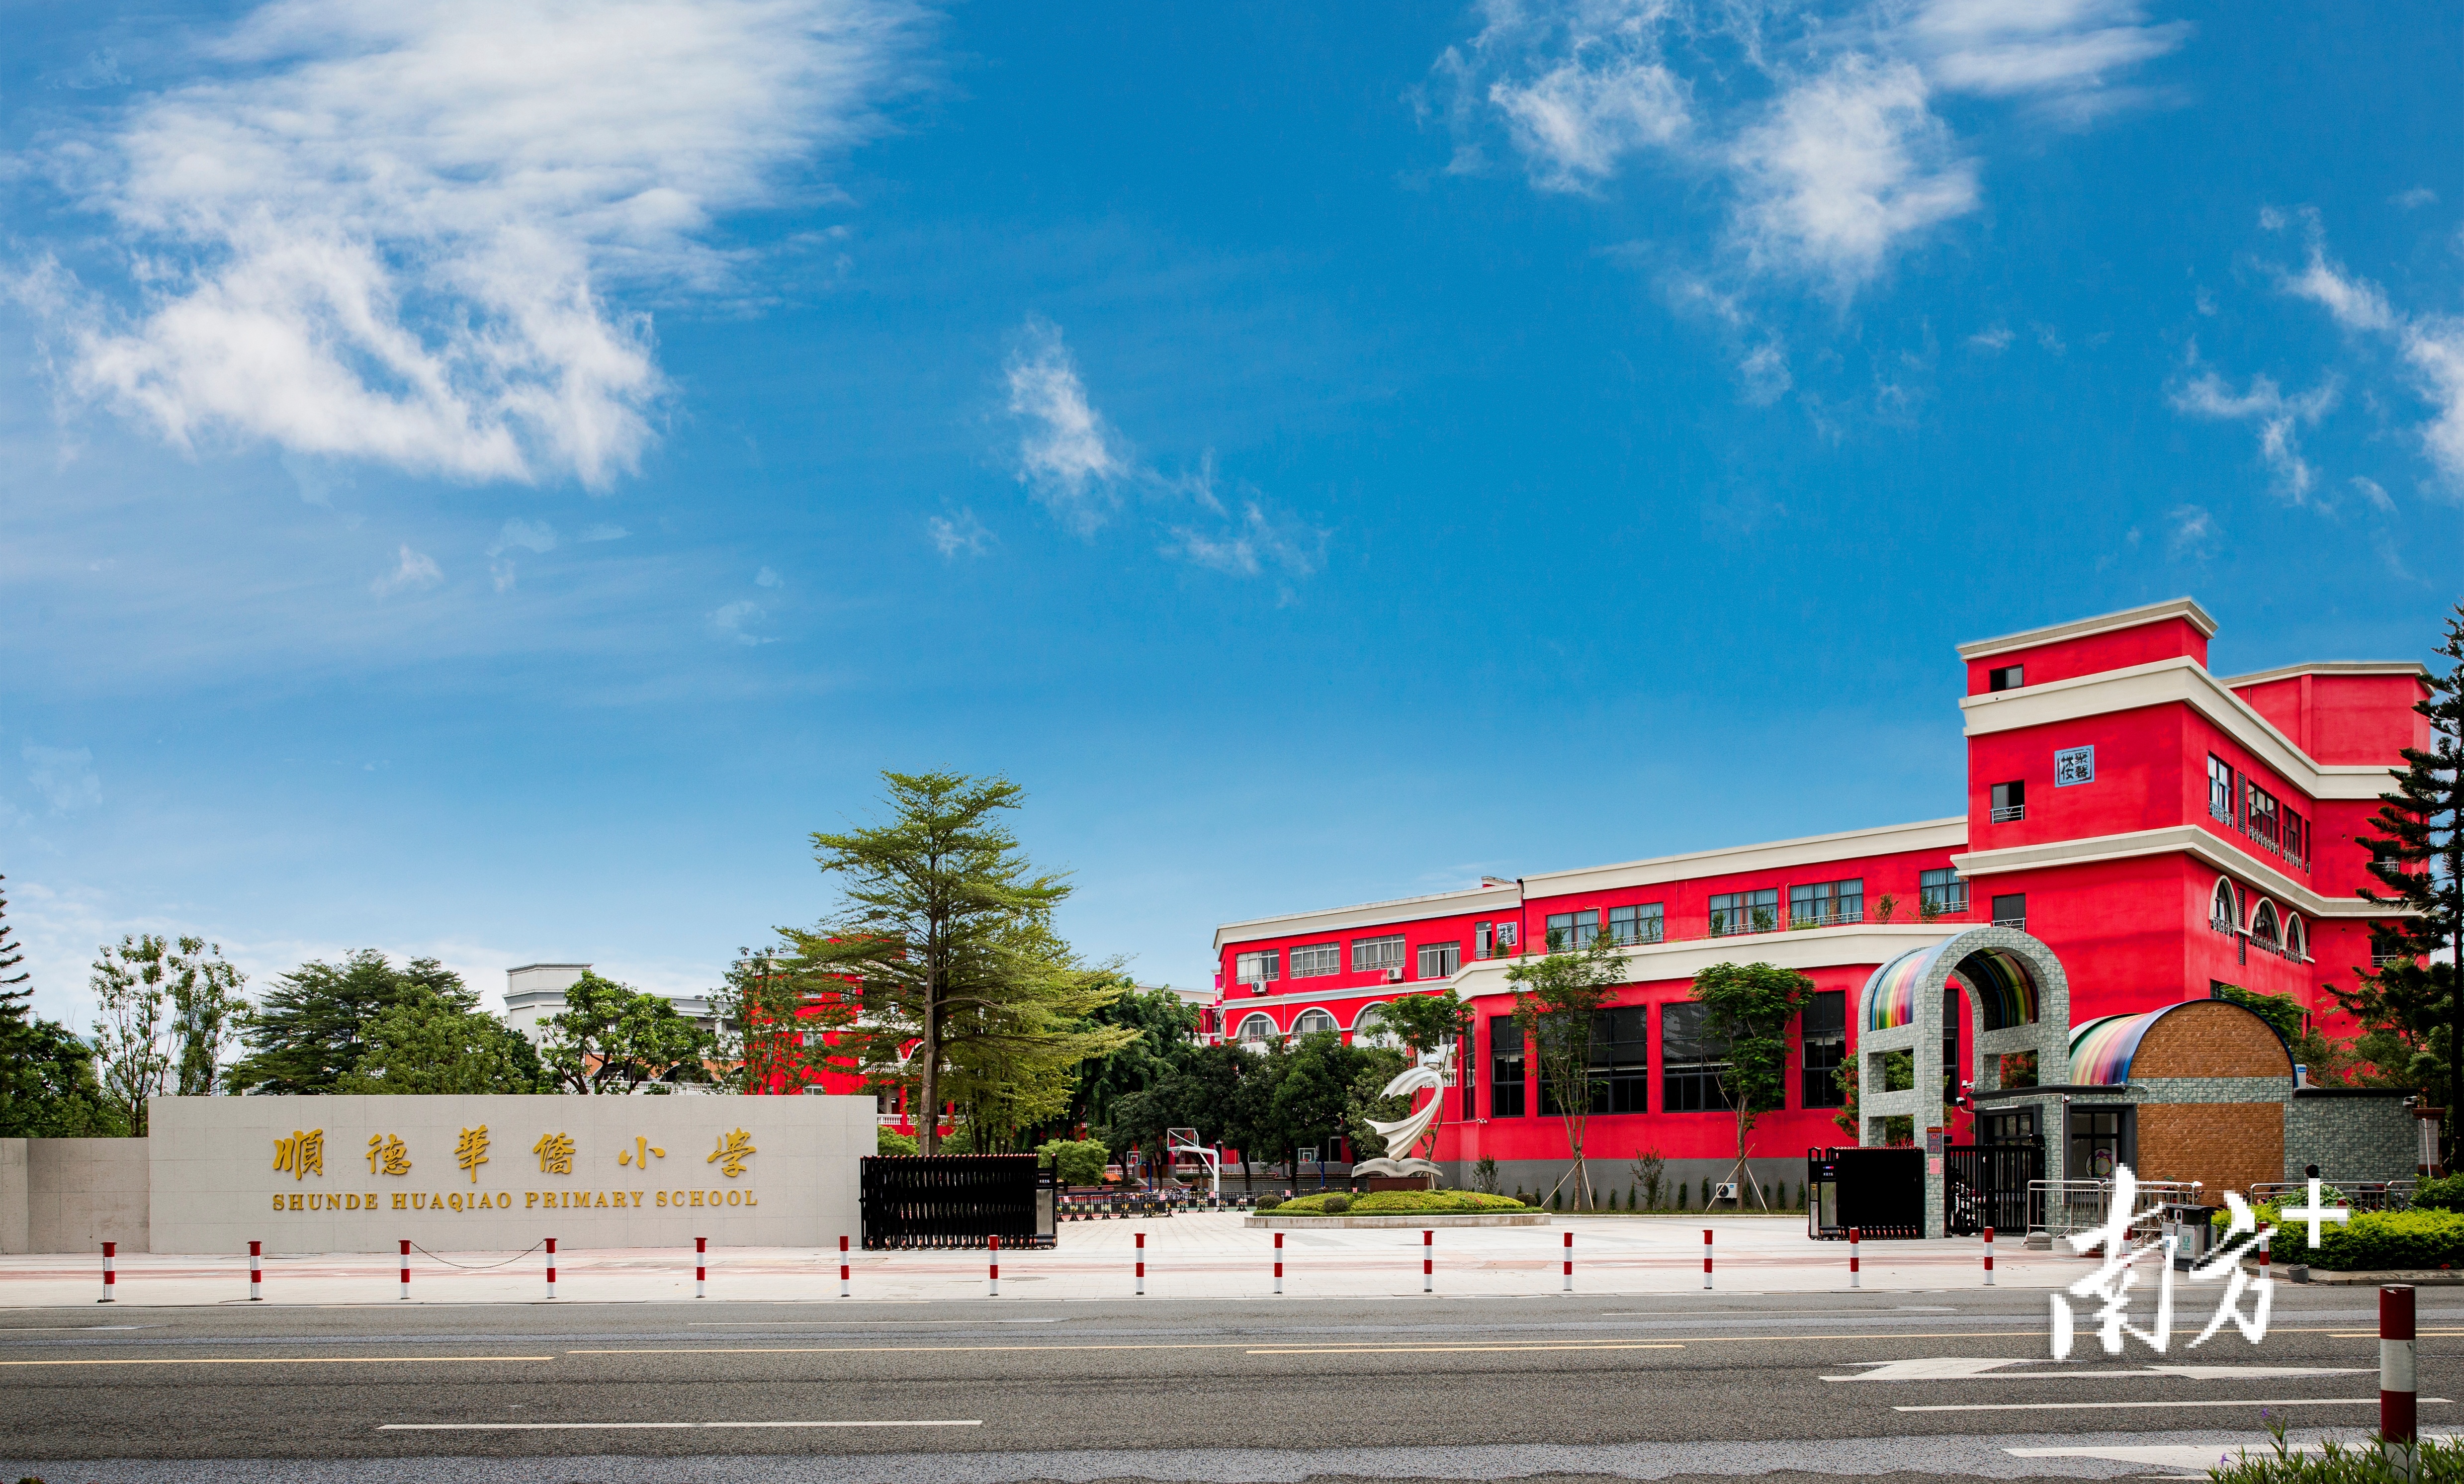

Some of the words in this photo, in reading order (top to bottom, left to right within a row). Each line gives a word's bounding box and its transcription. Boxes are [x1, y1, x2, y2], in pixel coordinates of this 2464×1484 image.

[272, 1125, 757, 1183] 順德華僑小學
[273, 1193, 378, 1211] SHUNDE
[391, 1192, 512, 1212] HUAQIAO
[525, 1191, 643, 1208] PRIMARY
[656, 1190, 757, 1207] SCHOOL
